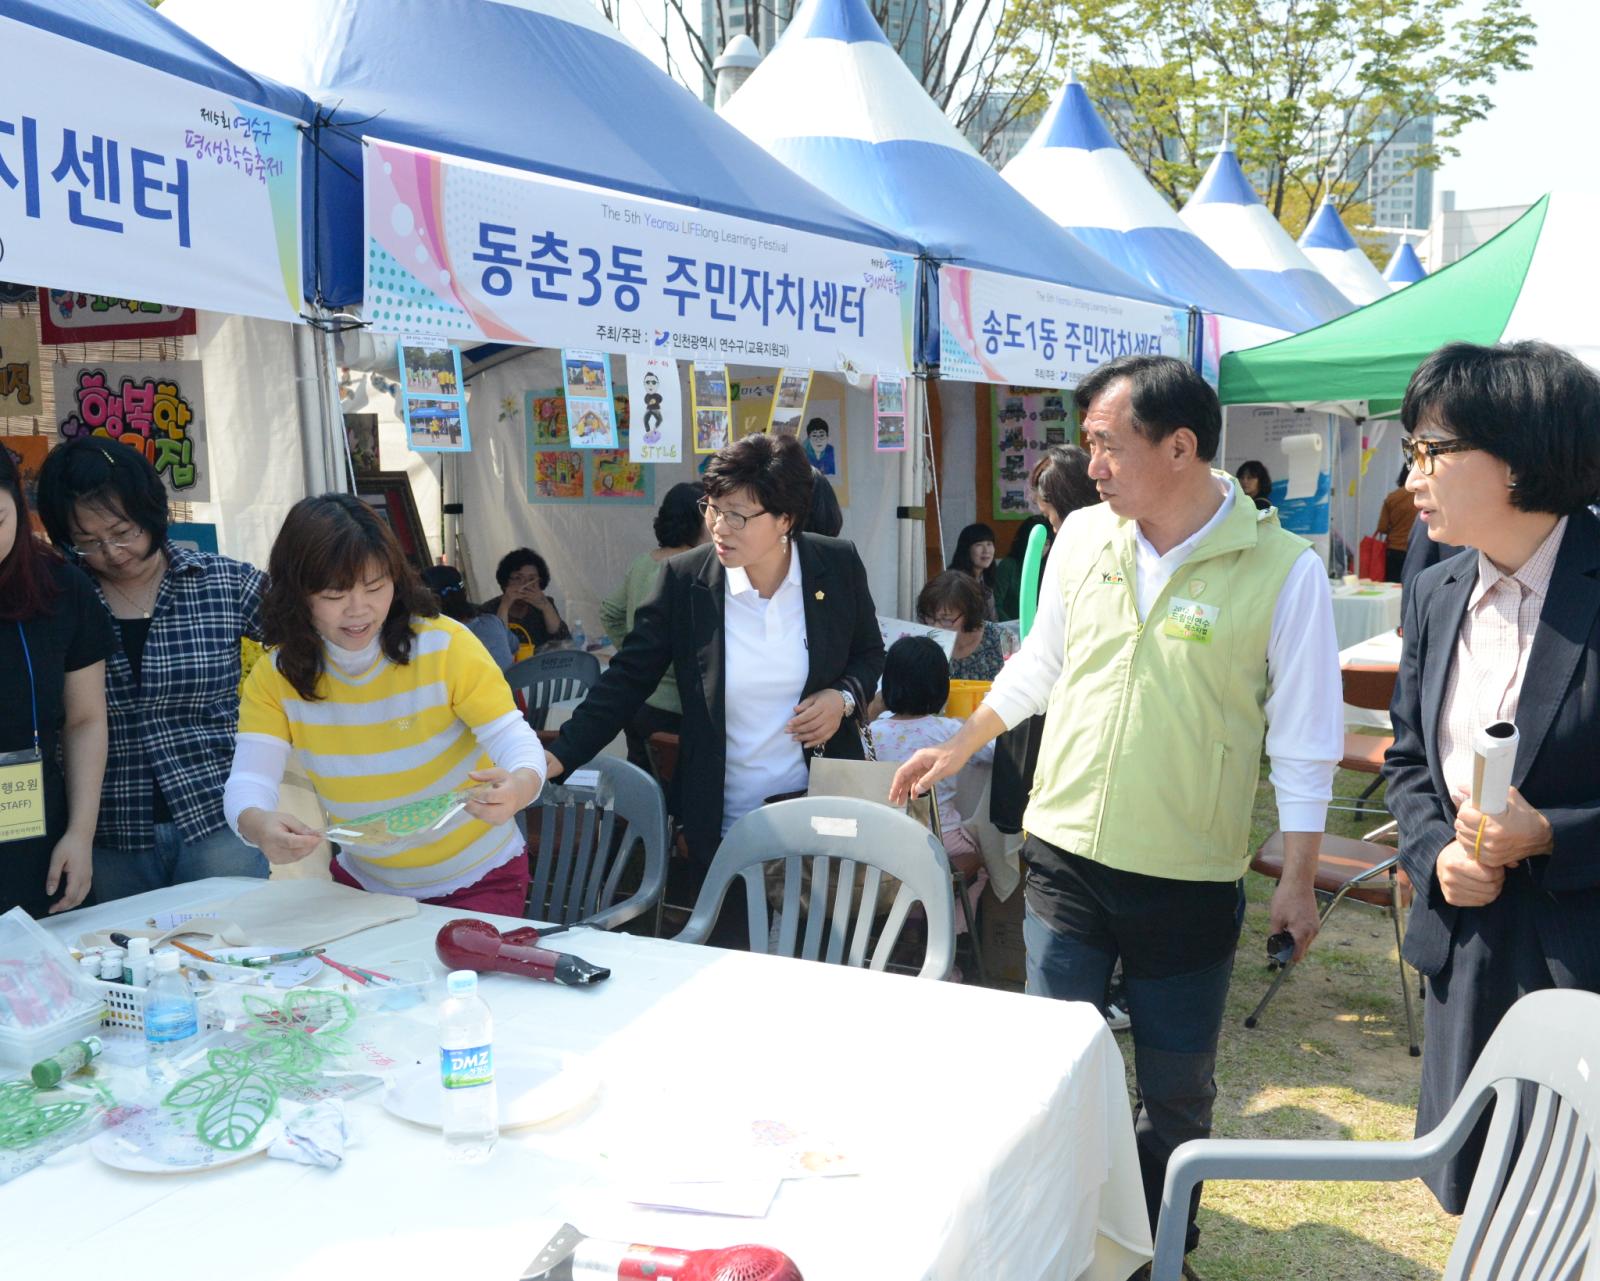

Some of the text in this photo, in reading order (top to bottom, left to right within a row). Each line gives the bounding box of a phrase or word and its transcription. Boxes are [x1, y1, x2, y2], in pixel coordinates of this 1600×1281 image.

[200, 108, 271, 144] 제5회 연수구
[185, 130, 283, 184] 평생학습축제
[601, 204, 789, 254] The 5th Yeonsu LIFElong Learning Festival
[472, 221, 866, 337] 동춘3동 주민자치센터
[672, 332, 717, 351] 인천광역시
[719, 339, 790, 359] 연수구(교육지원과)
[982, 309, 1058, 362] 송도1동
[77, 369, 193, 440] 행복한
[640, 444, 678, 459] STYLE
[0, 799, 32, 812] STAFF)
[451, 1051, 489, 1071] DMZ
